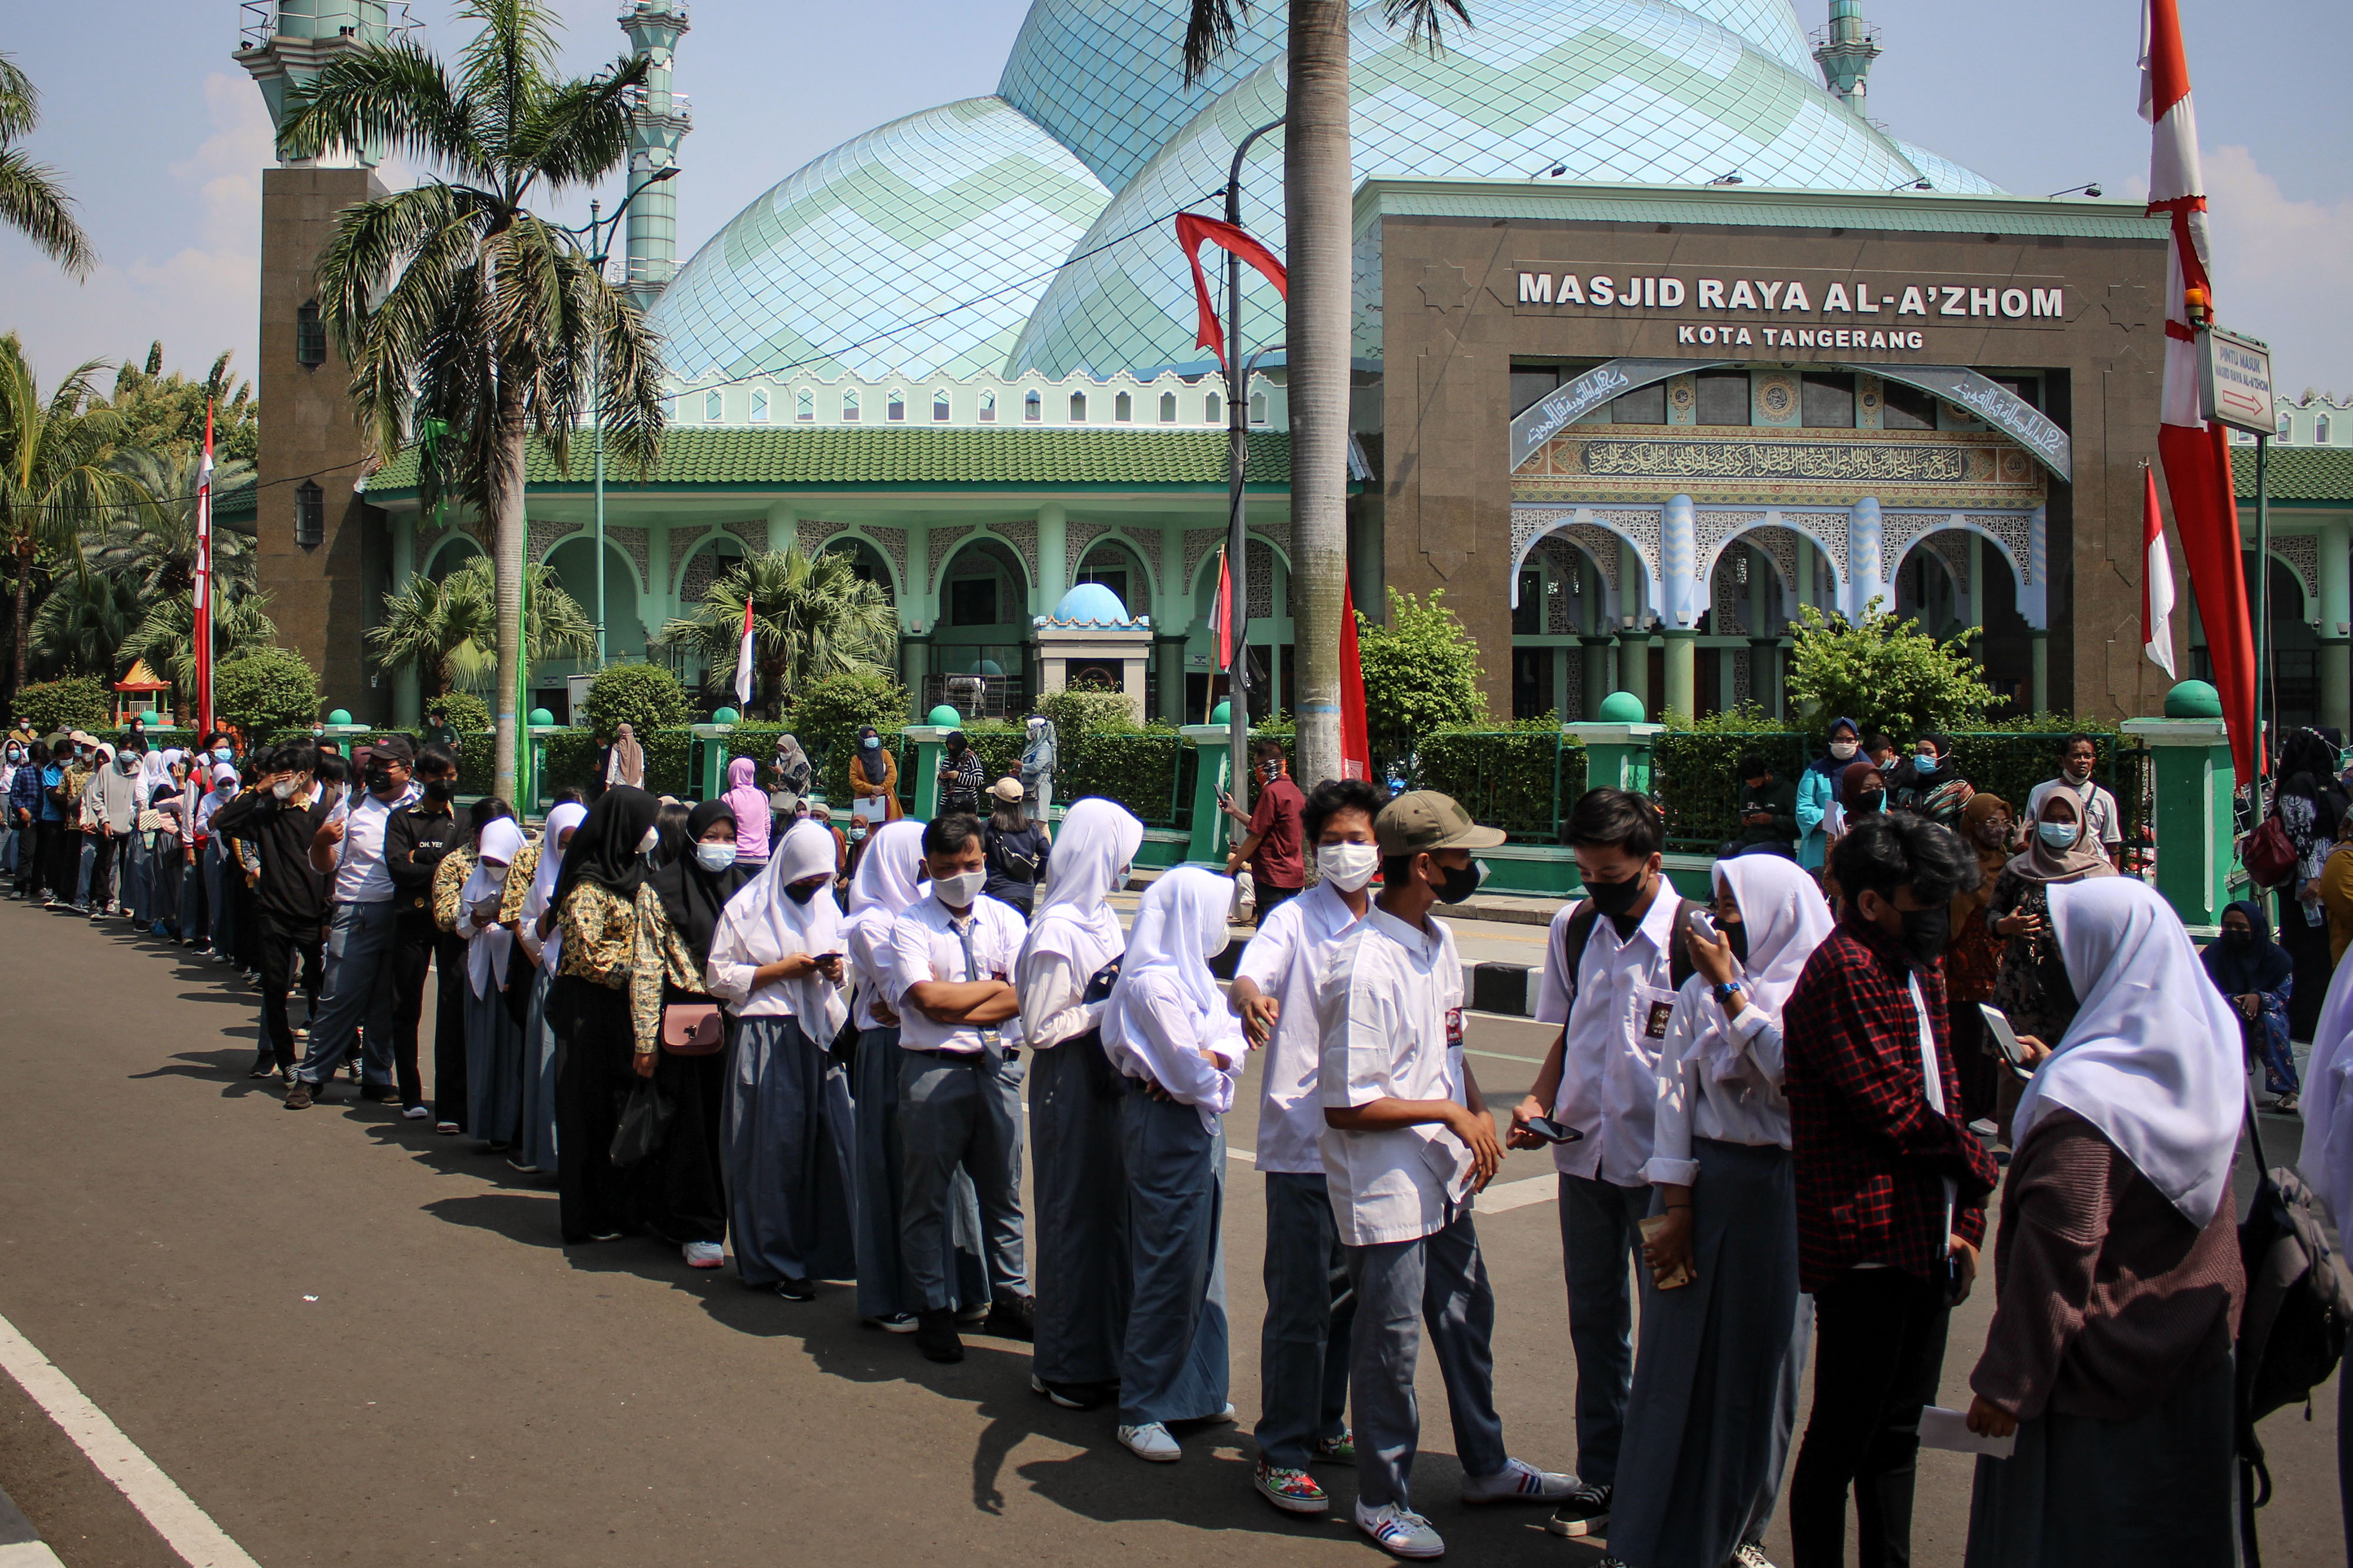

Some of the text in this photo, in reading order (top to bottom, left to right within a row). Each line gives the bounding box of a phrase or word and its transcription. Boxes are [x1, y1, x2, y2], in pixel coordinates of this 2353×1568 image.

[1519, 273, 2063, 317] MASJID RAYA AL-A'ZHOM
[1678, 326, 1923, 349] KOTA TANGERANG
[2219, 345, 2261, 374] PINTU MASUK
[2230, 369, 2243, 385] RAYA
